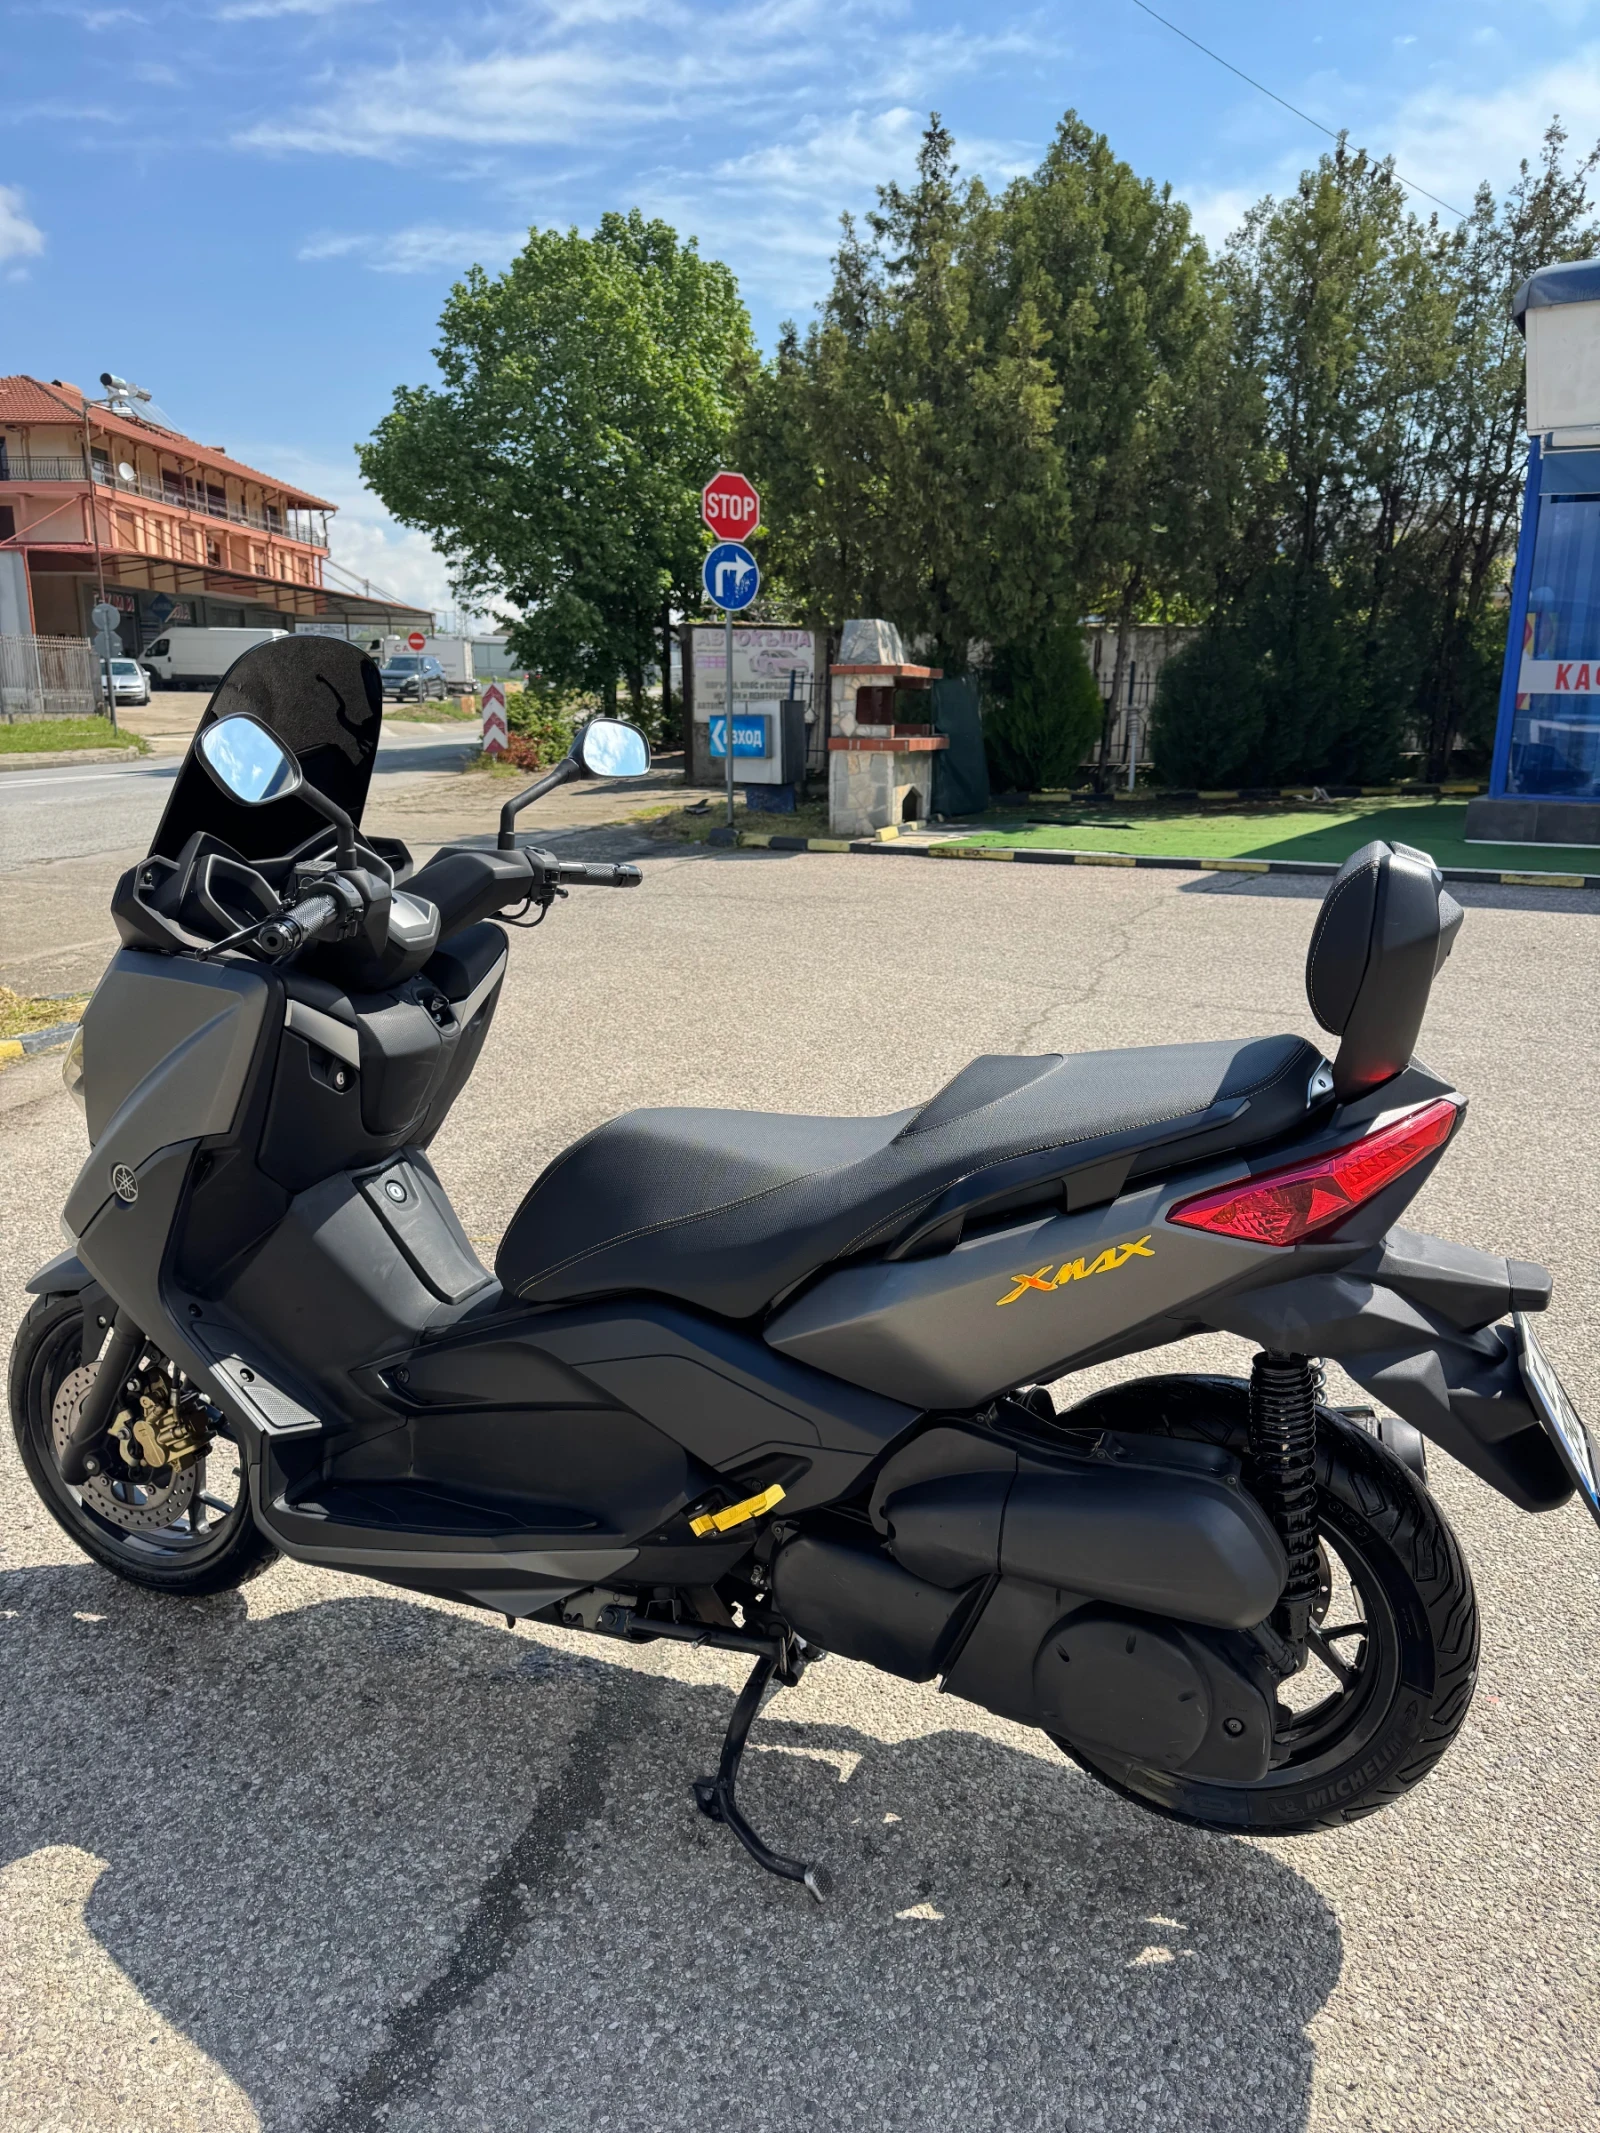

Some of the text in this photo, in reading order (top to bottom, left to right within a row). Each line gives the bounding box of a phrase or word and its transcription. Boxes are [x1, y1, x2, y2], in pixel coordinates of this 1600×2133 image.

[707, 492, 755, 521] STOP
[697, 631, 812, 651] АВОКЪЩА
[996, 1234, 1156, 1306] XMAX
[1305, 1732, 1404, 1810] MICHELIN
